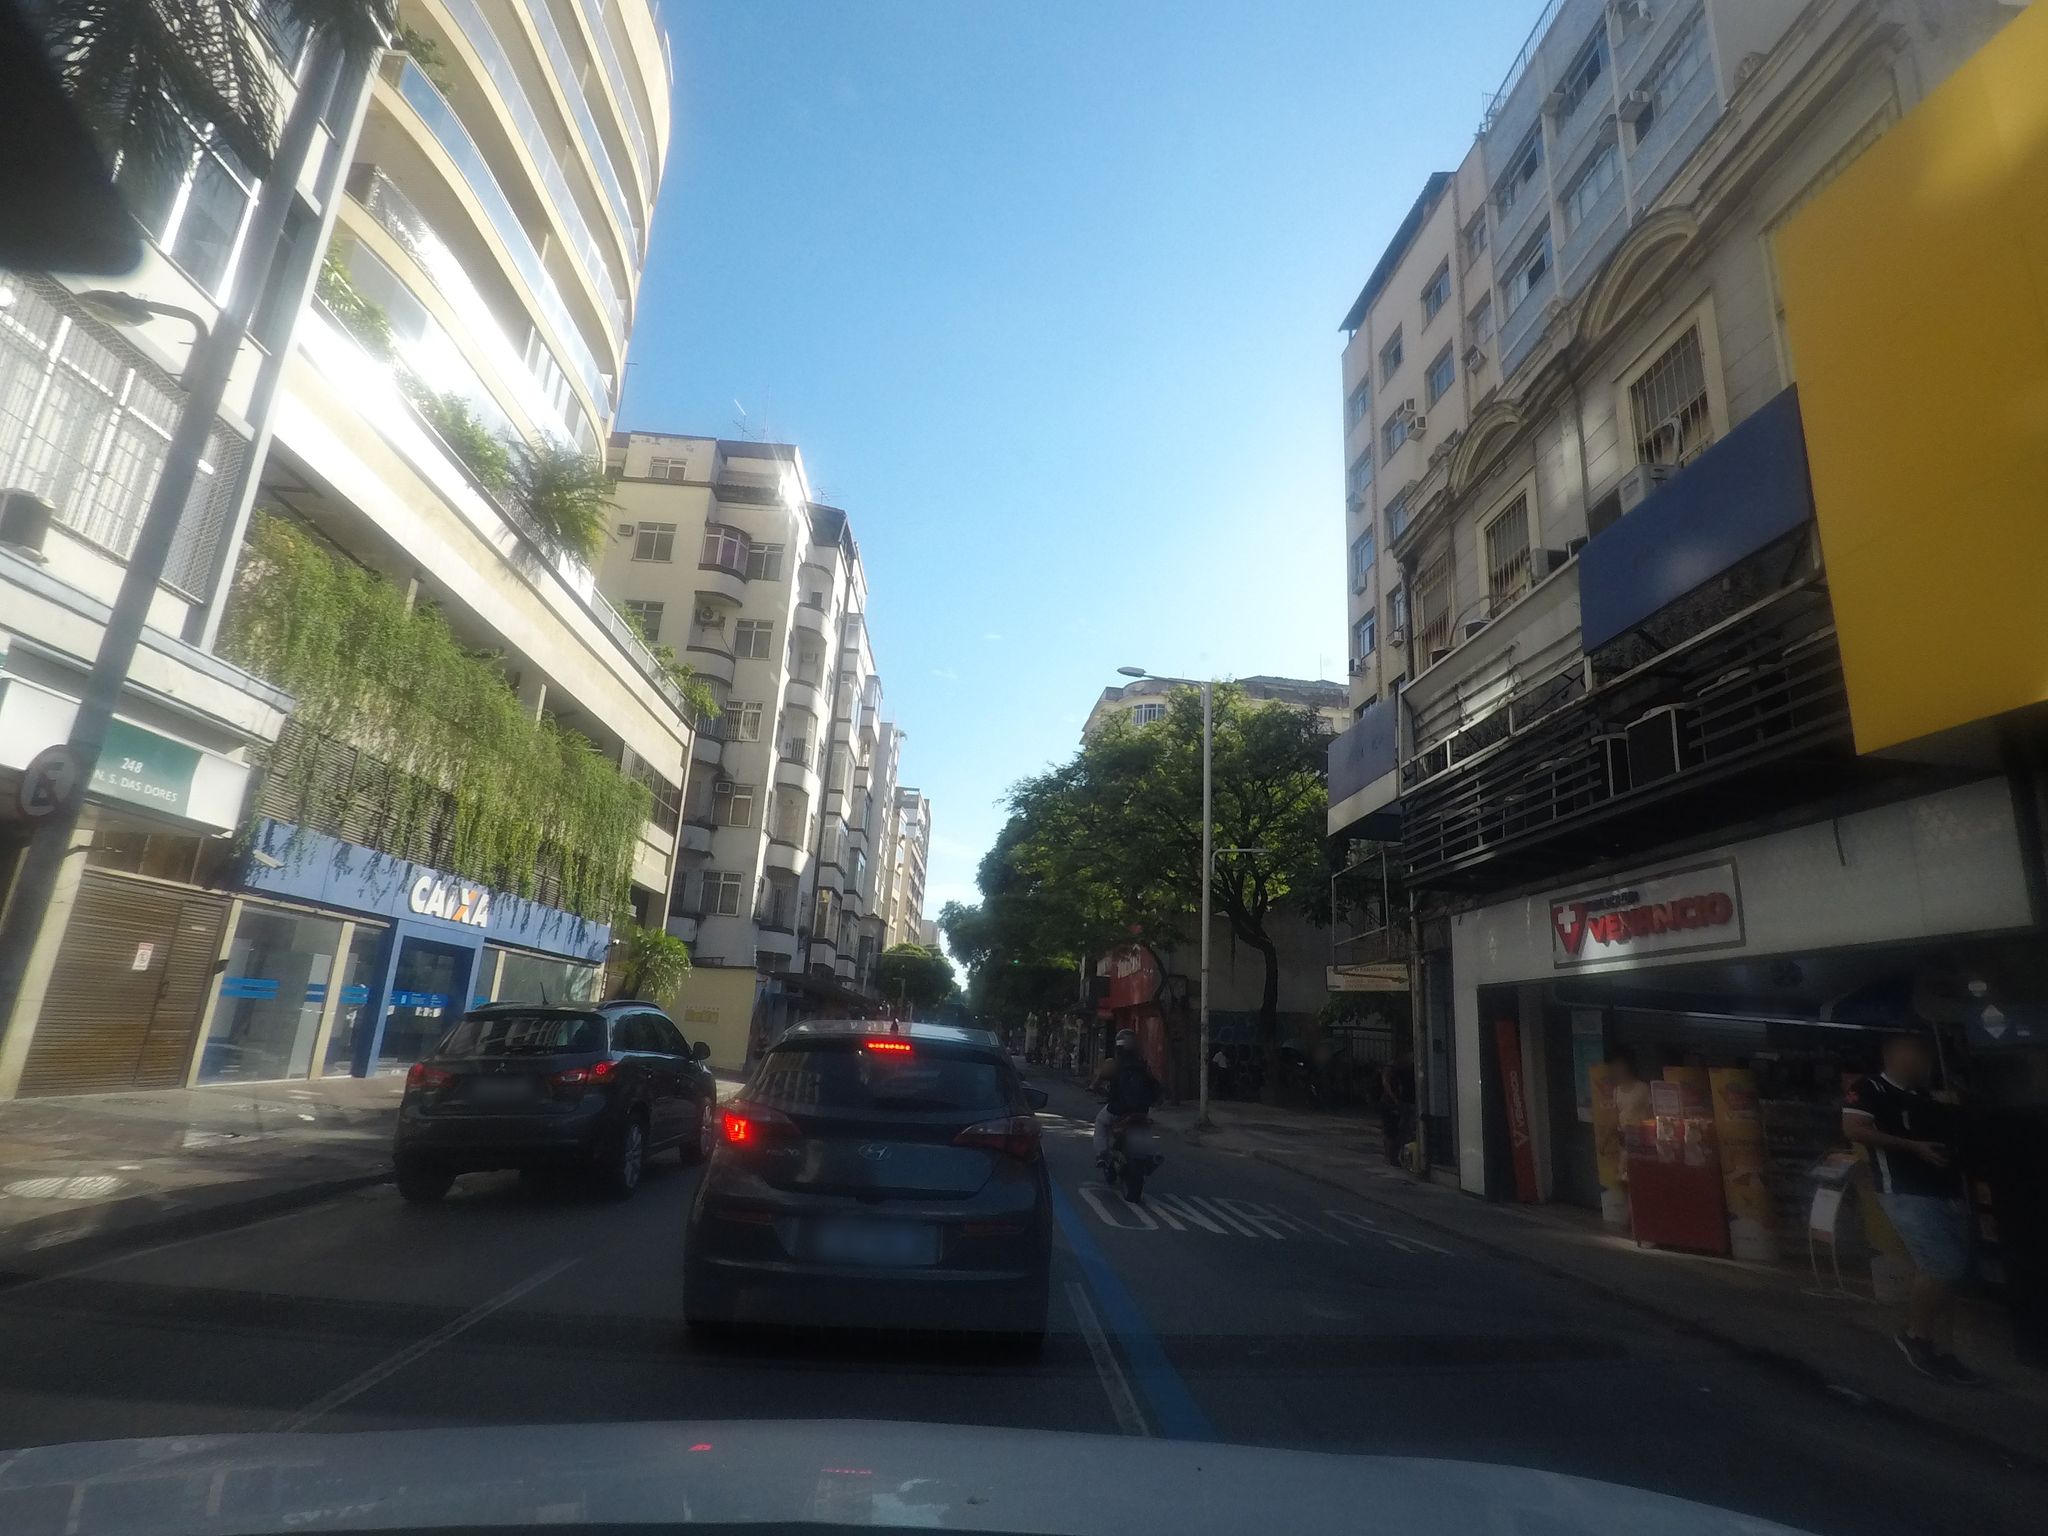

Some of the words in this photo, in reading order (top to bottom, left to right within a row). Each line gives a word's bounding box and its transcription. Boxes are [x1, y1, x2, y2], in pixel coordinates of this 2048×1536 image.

[120, 757, 144, 774] 248
[120, 777, 143, 792] DAS
[143, 784, 178, 802] DORES
[408, 876, 490, 928] CAIXA
